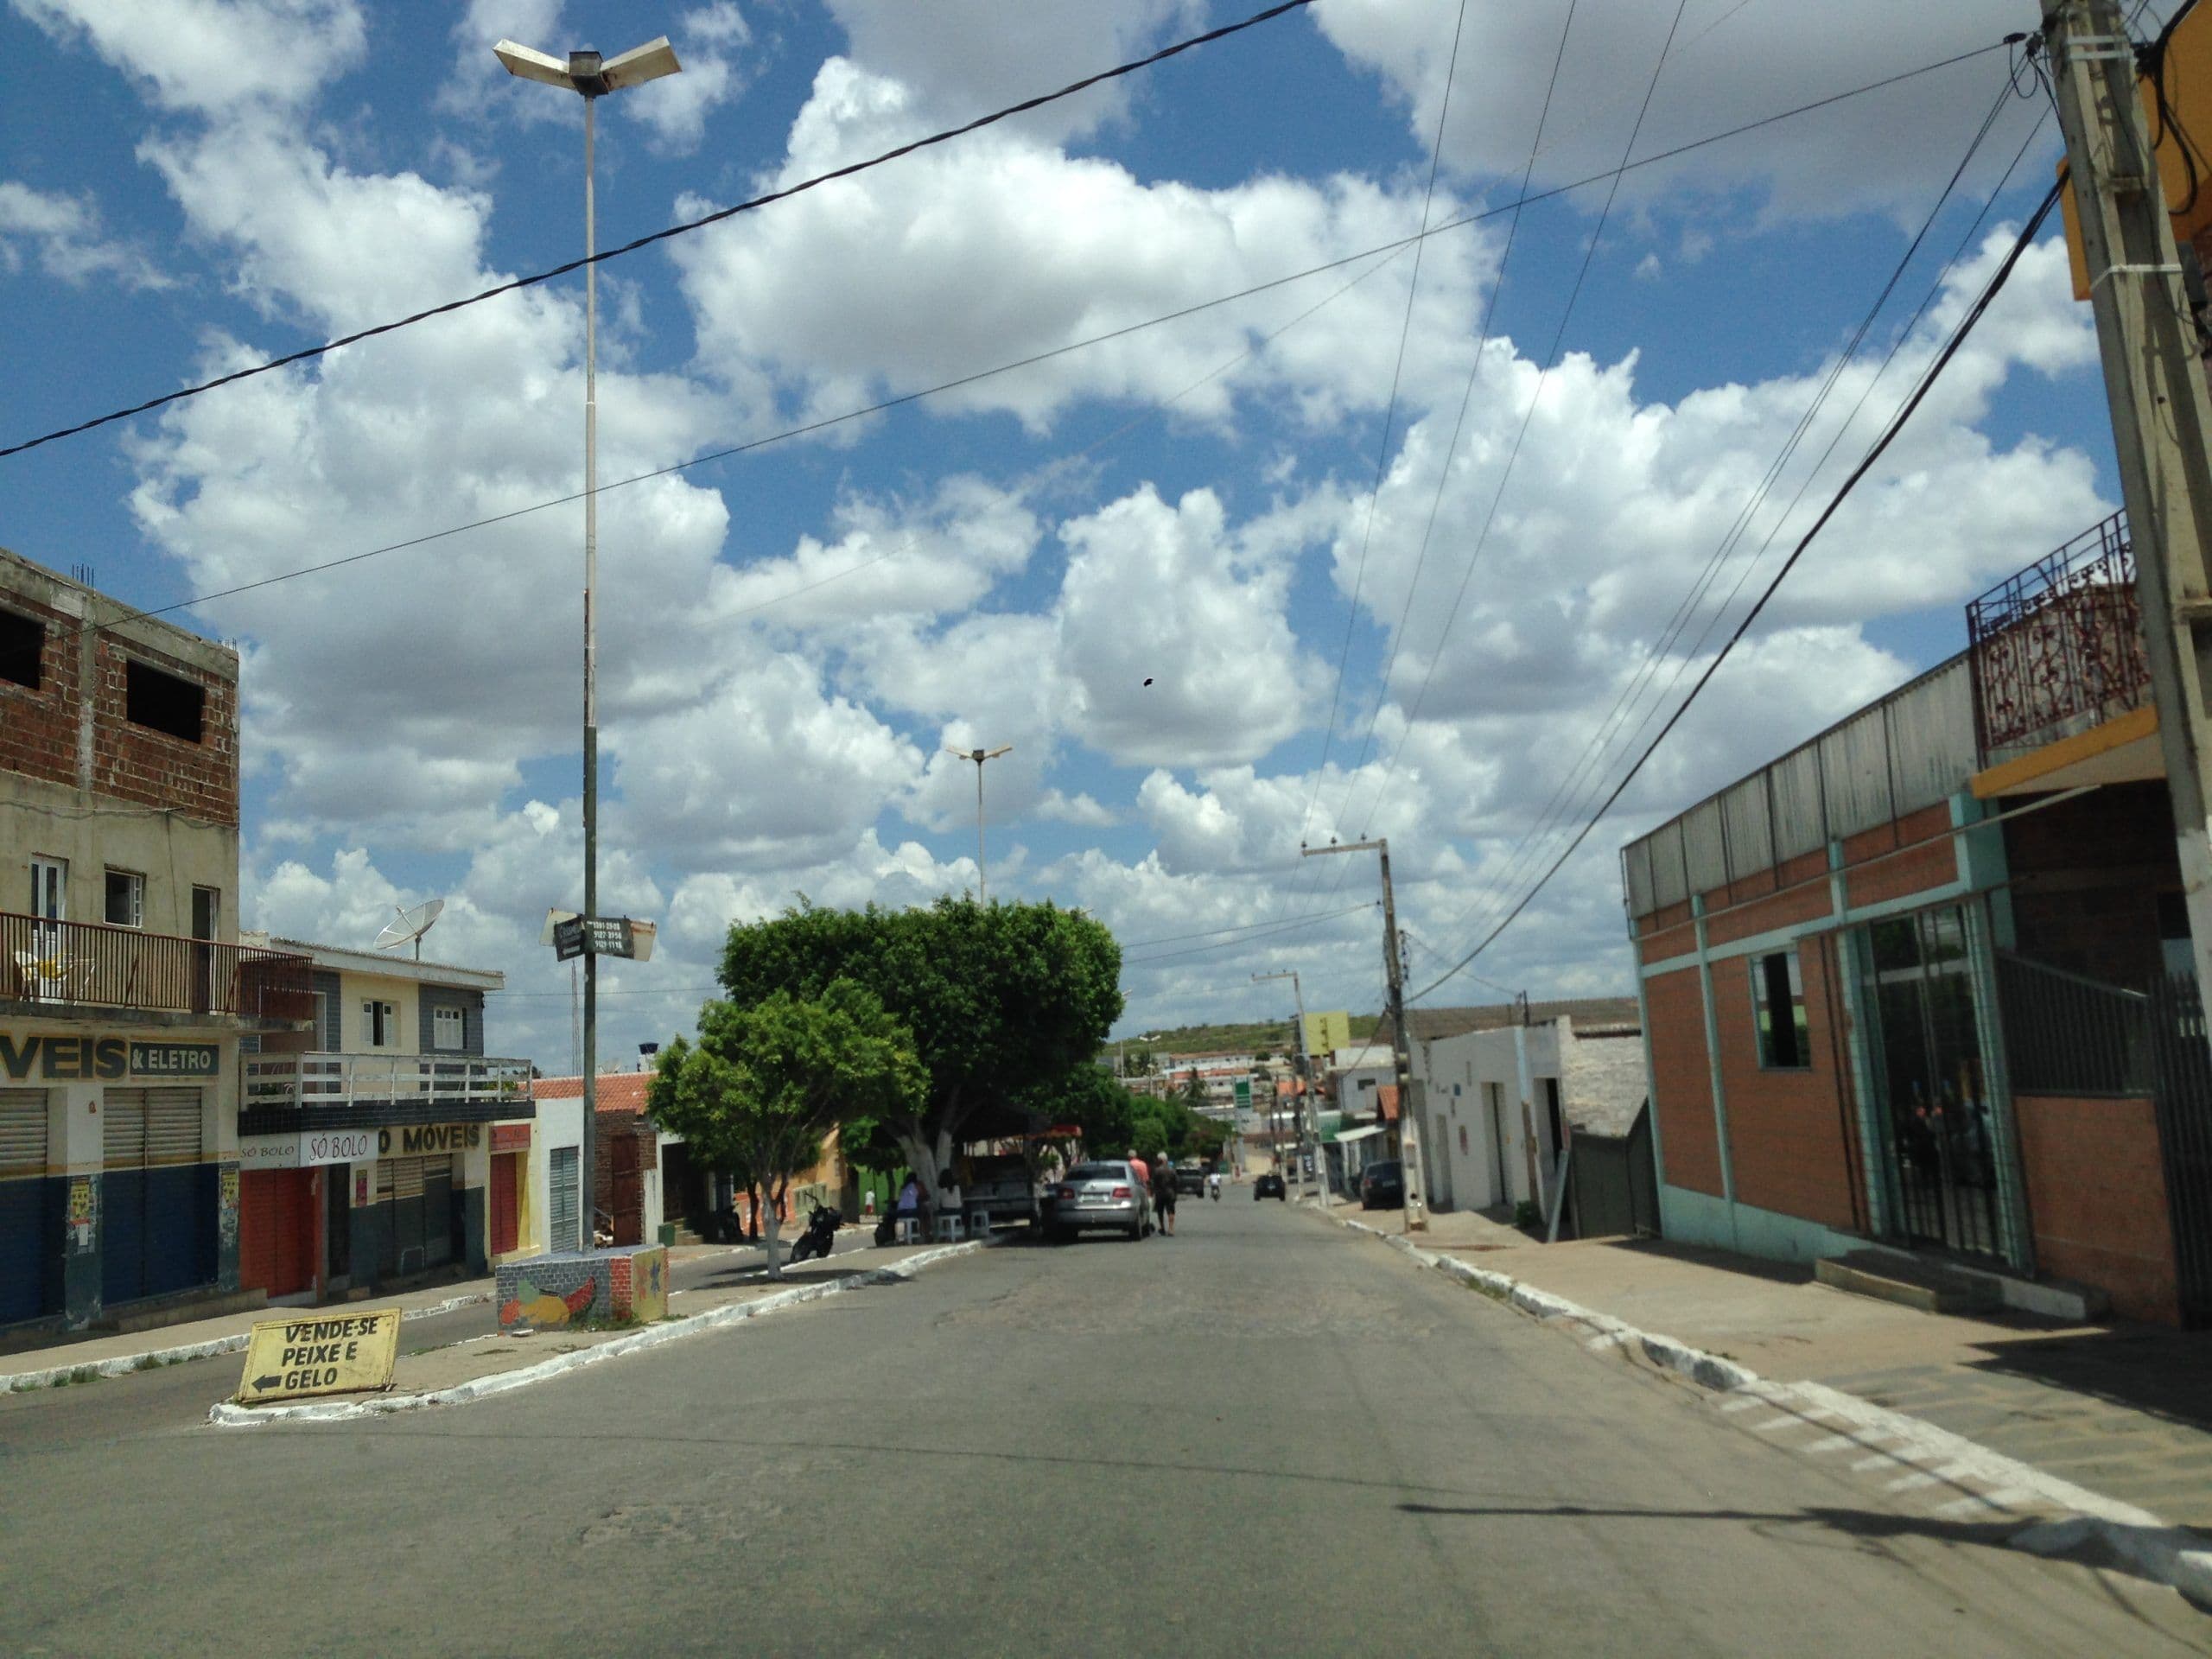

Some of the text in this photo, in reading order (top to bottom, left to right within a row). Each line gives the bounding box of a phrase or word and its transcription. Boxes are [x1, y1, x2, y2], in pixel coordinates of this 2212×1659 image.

[131, 1048, 143, 1070] &
[148, 1049, 211, 1070] ELETRO
[260, 1145, 295, 1157] BOLO
[309, 1133, 368, 1160] SÓ BOLO
[285, 1316, 378, 1344] VENDE-SE
[281, 1341, 358, 1367] PEIXE E
[284, 1367, 338, 1390] GELO
